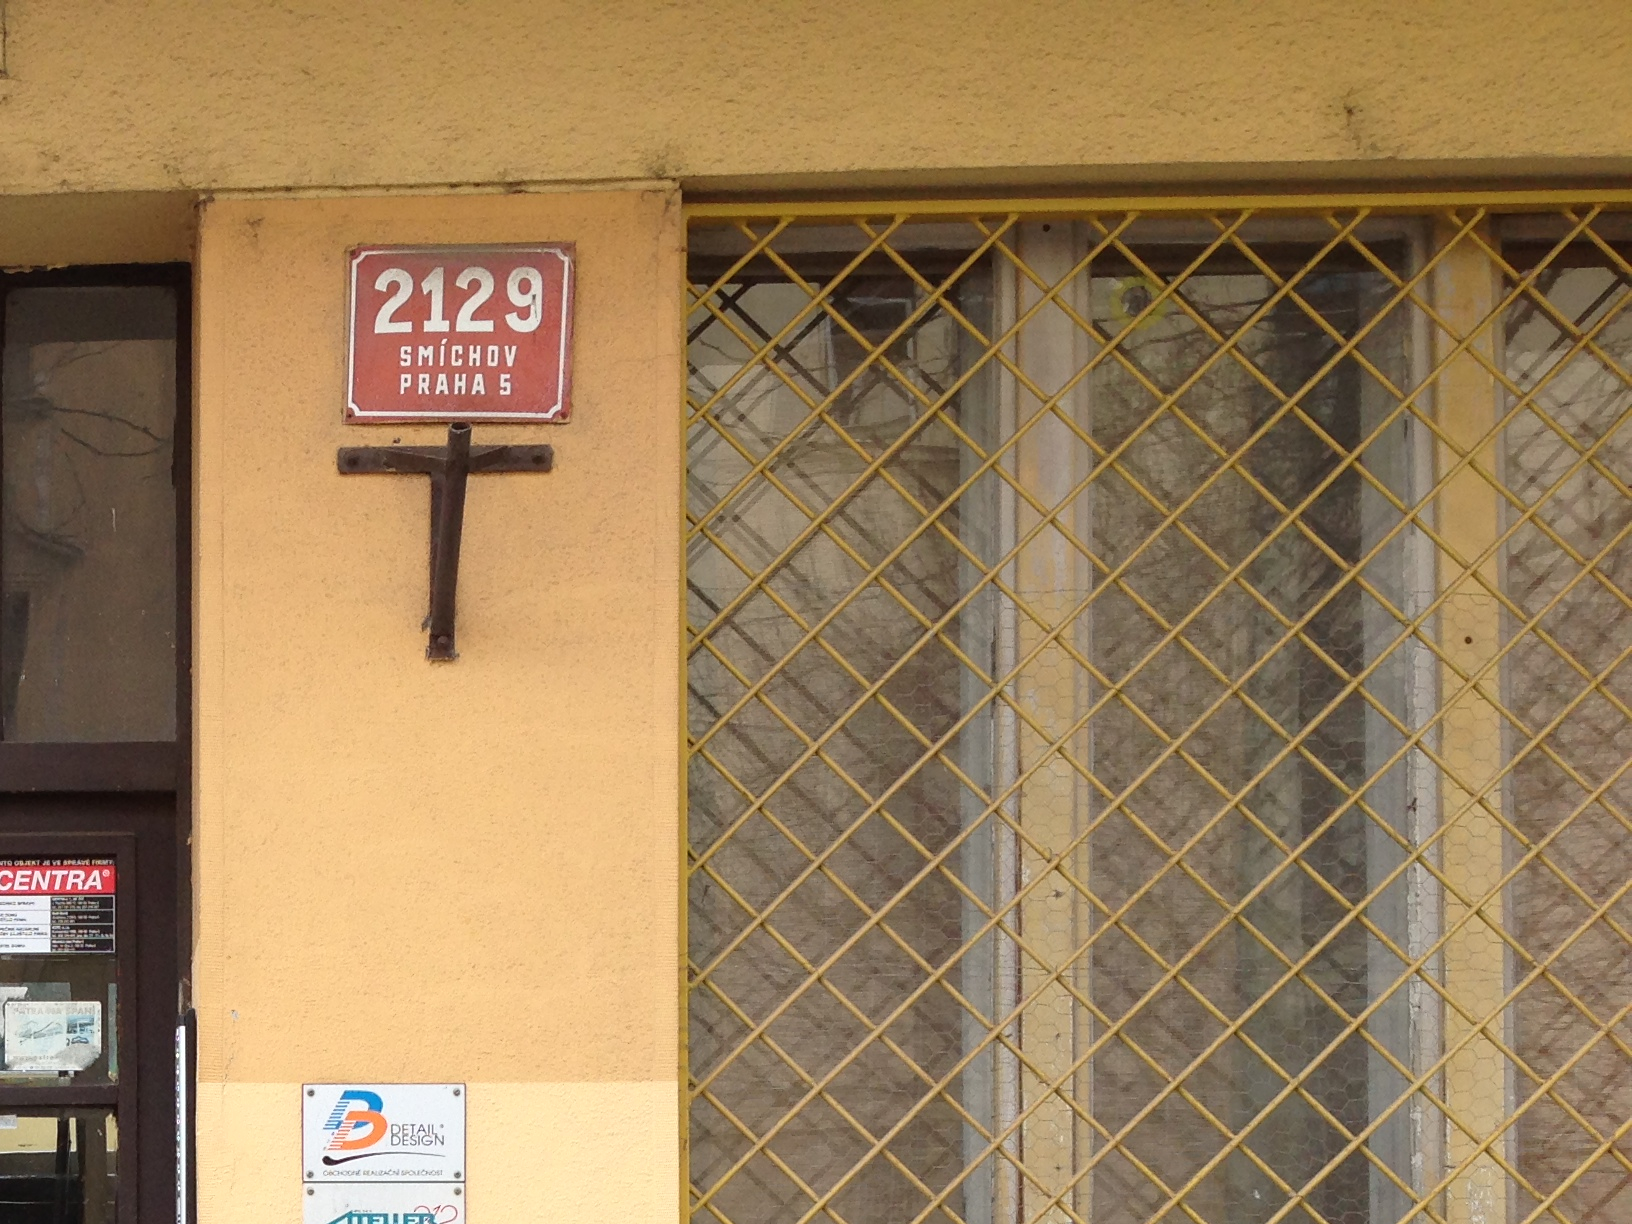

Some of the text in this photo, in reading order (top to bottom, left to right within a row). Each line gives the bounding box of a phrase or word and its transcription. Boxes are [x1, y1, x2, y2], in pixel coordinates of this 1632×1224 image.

[374, 266, 543, 334] 2129
[400, 338, 518, 367] SMÍCHOV
[400, 373, 512, 395] PRAHA 5
[390, 1123, 438, 1136] DETAIL
[390, 1134, 445, 1147] DESIGN
